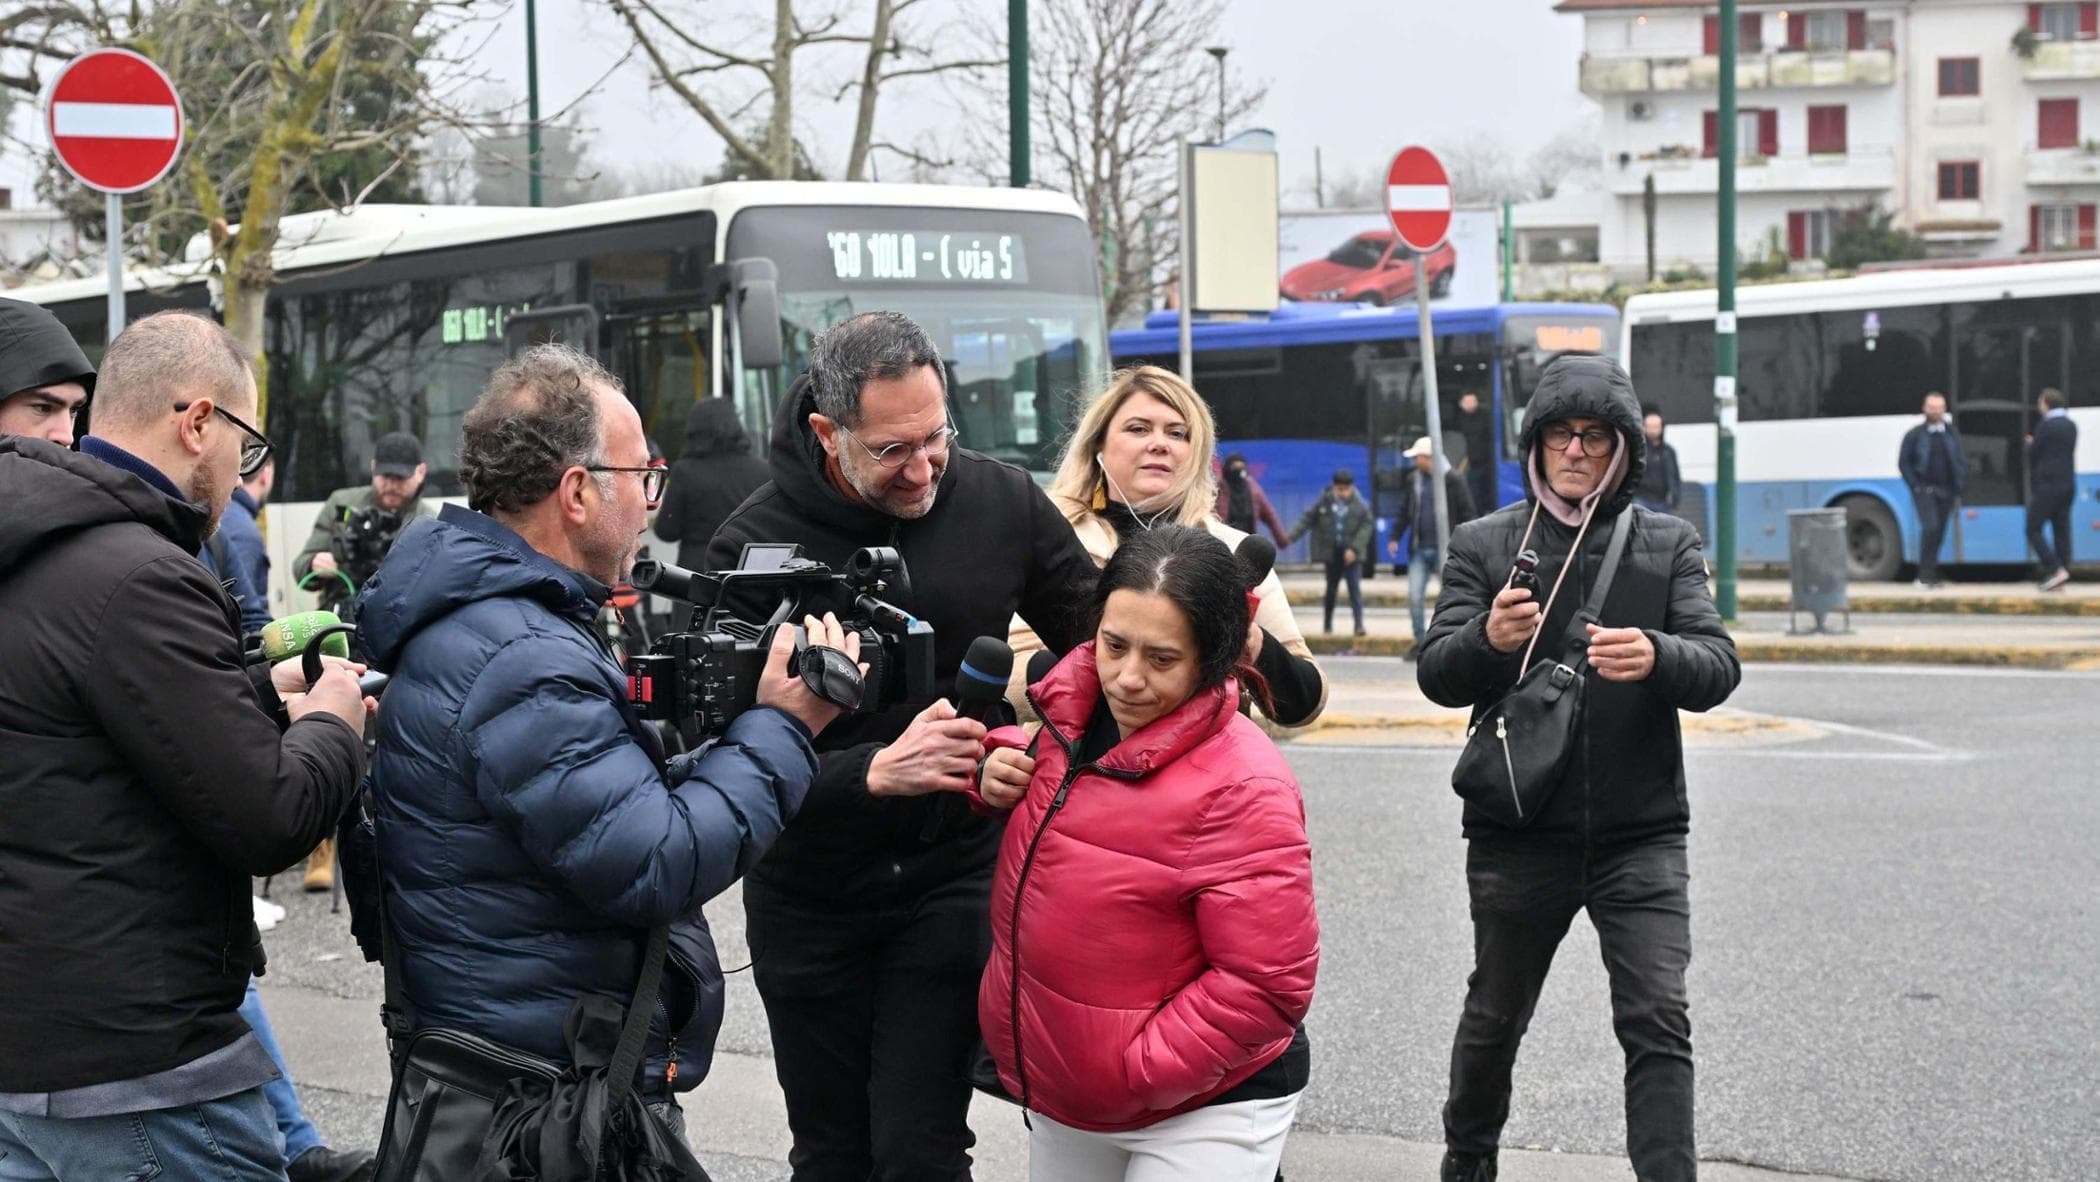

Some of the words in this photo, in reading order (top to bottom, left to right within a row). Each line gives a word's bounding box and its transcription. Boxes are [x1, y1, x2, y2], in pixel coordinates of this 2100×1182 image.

[958, 240, 994, 279] via
[999, 235, 1012, 279] S
[838, 664, 861, 685] SONY
